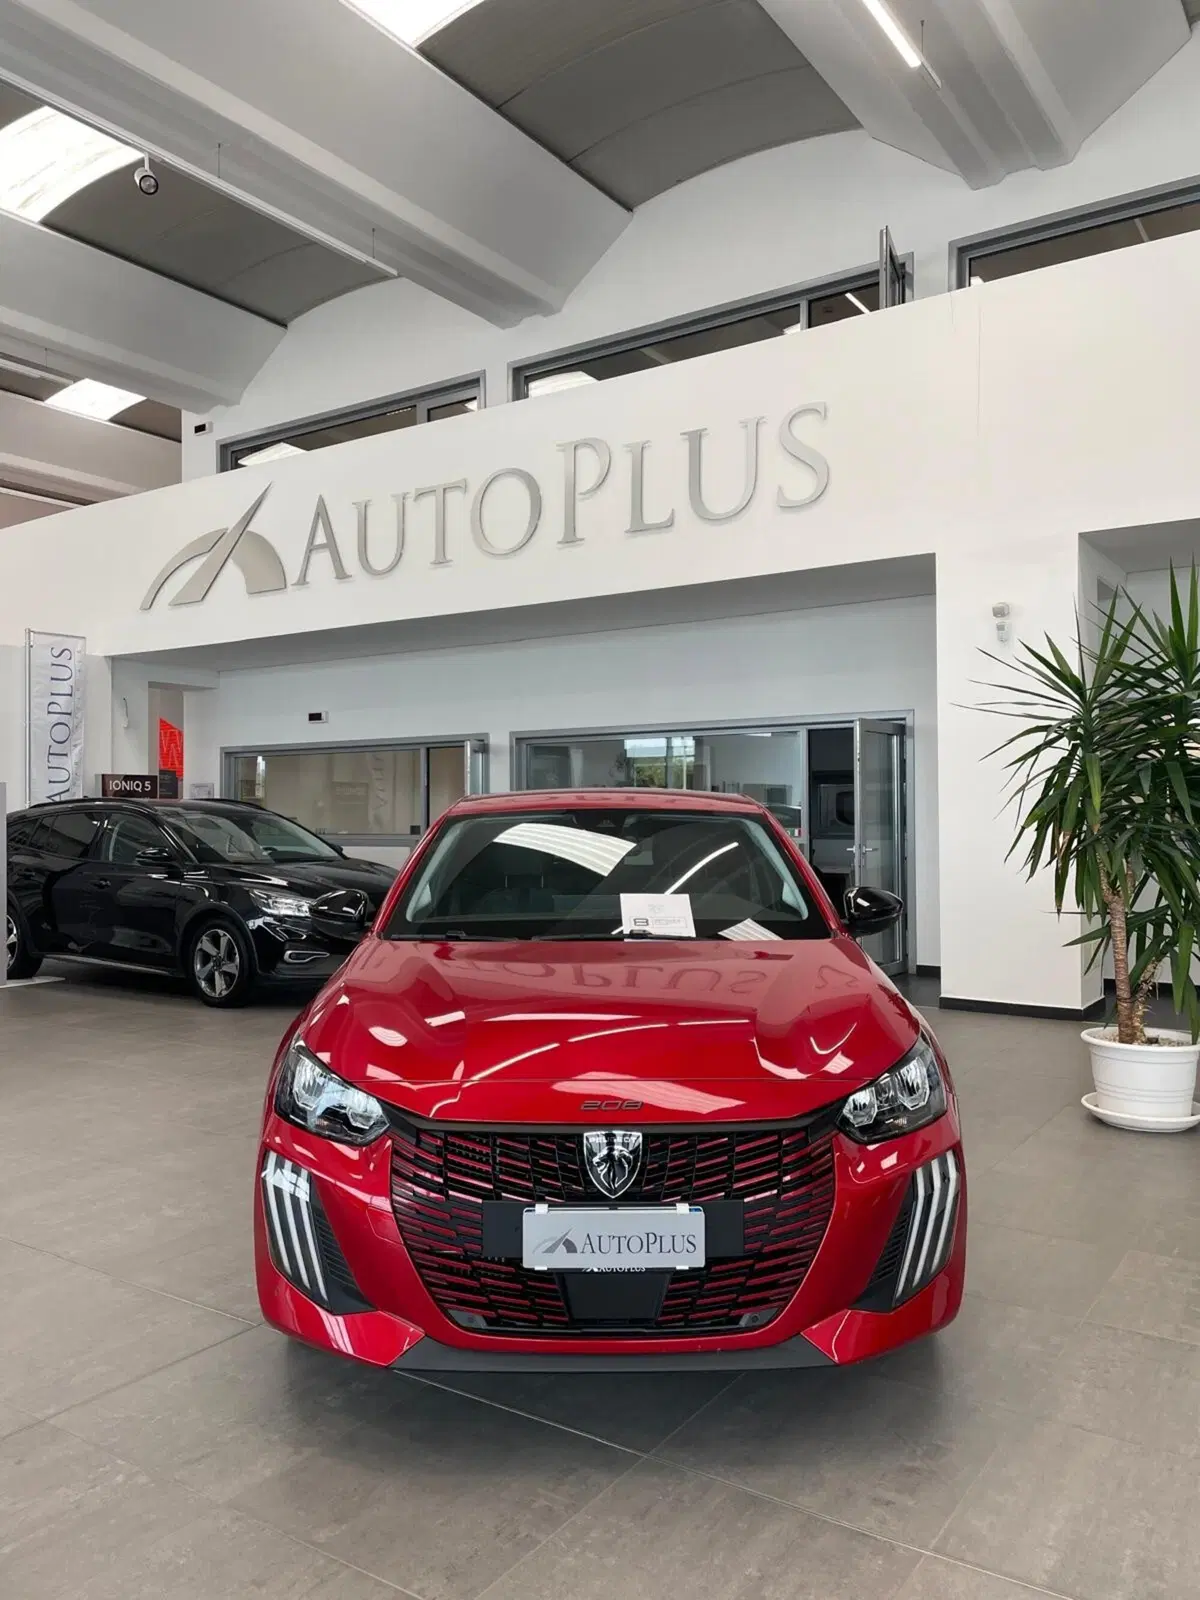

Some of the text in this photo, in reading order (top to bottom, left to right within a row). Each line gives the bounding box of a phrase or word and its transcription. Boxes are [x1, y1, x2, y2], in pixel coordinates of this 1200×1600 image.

[46, 646, 73, 804] AUTOPLUS
[109, 780, 142, 792] IONIQ
[144, 781, 152, 791] 5
[581, 1100, 642, 1110] 208
